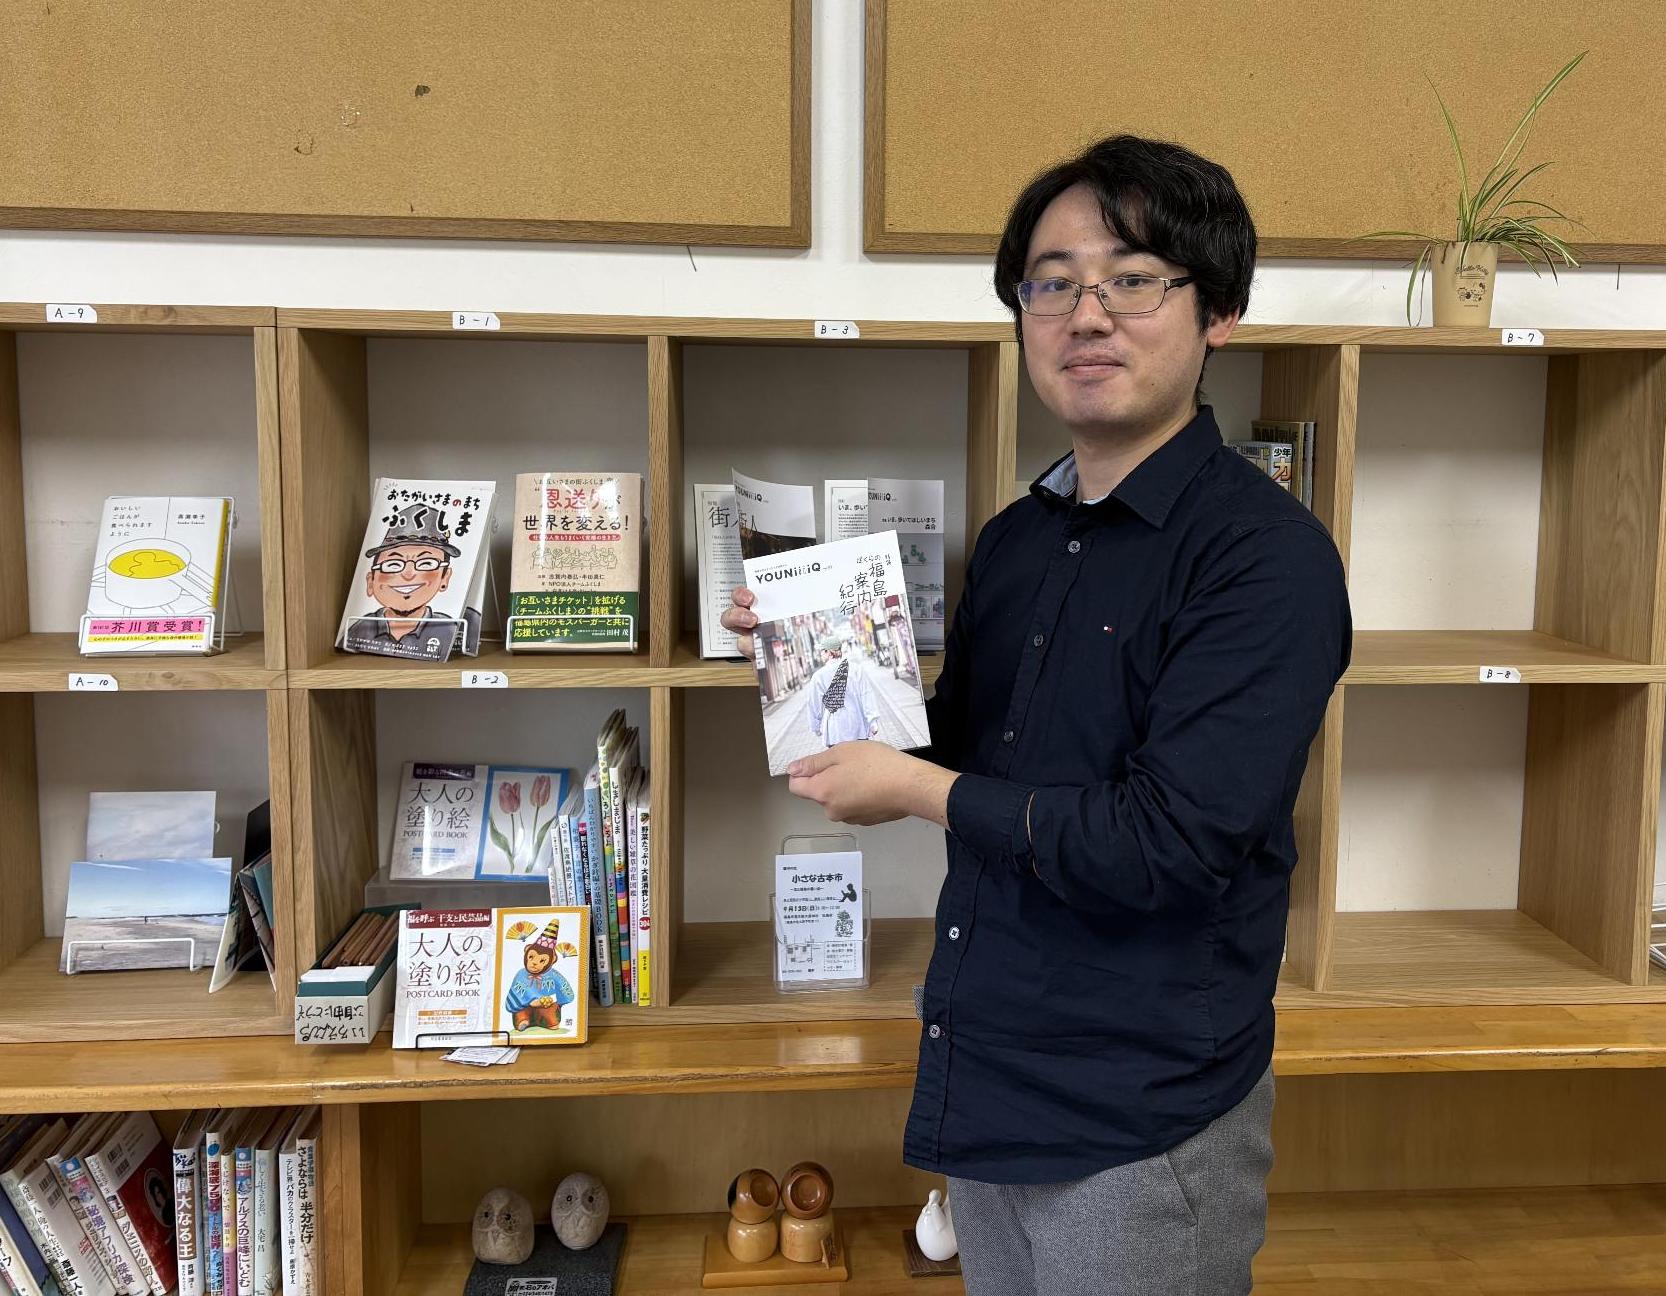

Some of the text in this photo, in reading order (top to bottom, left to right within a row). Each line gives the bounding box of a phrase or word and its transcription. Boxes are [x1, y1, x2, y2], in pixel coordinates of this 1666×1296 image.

[1273, 448, 1291, 457] 少年
[387, 489, 481, 511] おたがいさまのまち
[382, 505, 472, 537] ふくしま
[854, 571, 872, 606] 案内
[868, 562, 887, 597] 福島
[515, 595, 626, 605] 「お互いさまチケット」を拡げる
[839, 583, 858, 616] 紀行
[111, 620, 202, 633] 芥川賞受賞!
[514, 628, 573, 637] 応援しています。
[515, 618, 629, 627] 福島県内のモスバーガーと共に
[410, 782, 474, 803] 大人の
[446, 830, 468, 839] BOOK
[641, 826, 649, 866] 野菜たっぷり
[791, 873, 843, 884] 小さな古本市
[641, 868, 650, 916] 大量消費レシピ
[409, 932, 483, 958] 大人の
[407, 960, 481, 987] 塗り絵
[406, 989, 481, 999] POSTCARD BOOK
[298, 1147, 314, 1244] さよならは 半分だけ
[176, 1178, 195, 1258] 偉大なる王
[85, 1205, 135, 1285] 秘境アフリカ探検
[238, 1197, 250, 1288] アルプスの巨峰にいどむ
